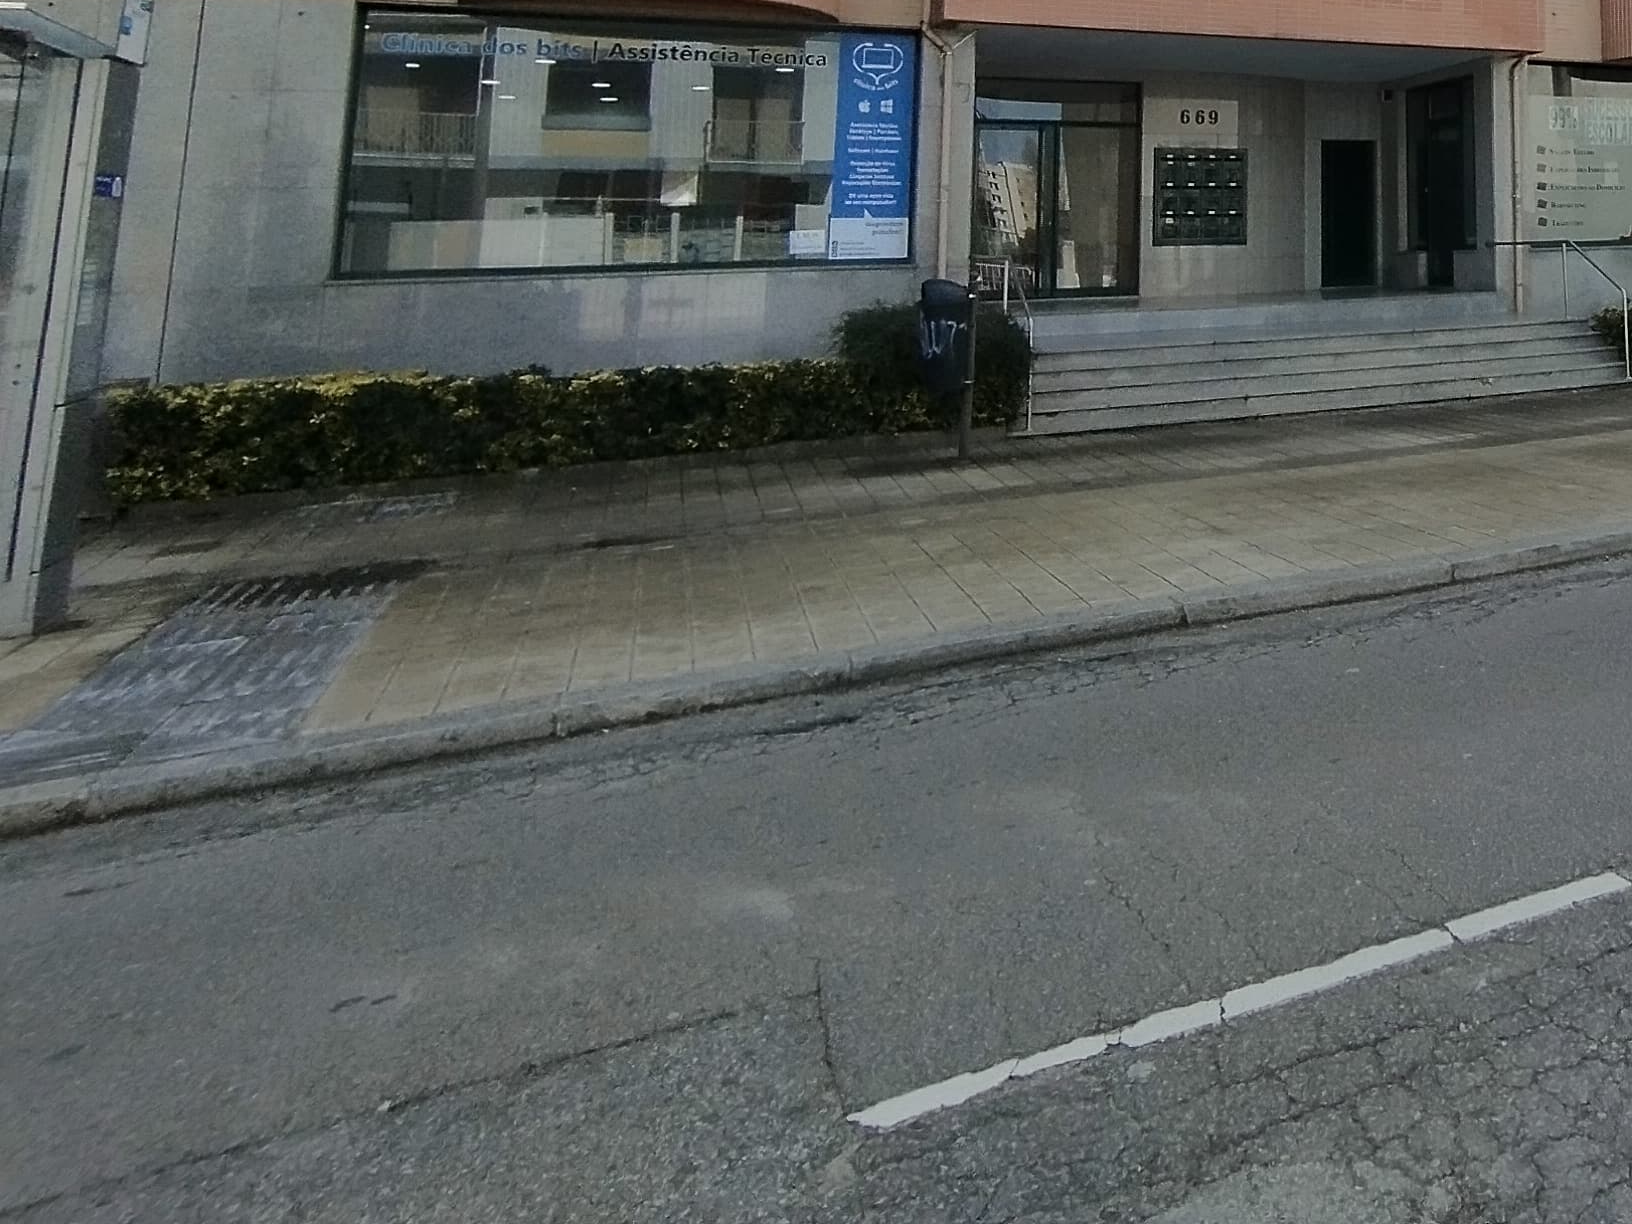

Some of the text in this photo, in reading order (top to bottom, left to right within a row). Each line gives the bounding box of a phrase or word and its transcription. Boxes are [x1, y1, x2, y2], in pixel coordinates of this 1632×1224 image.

[482, 36, 528, 55] dos
[537, 38, 584, 57] bits
[608, 42, 740, 63] Assistência
[747, 47, 828, 66] Técnica
[1180, 109, 1219, 125] 669
[1550, 106, 1578, 129] 99%
